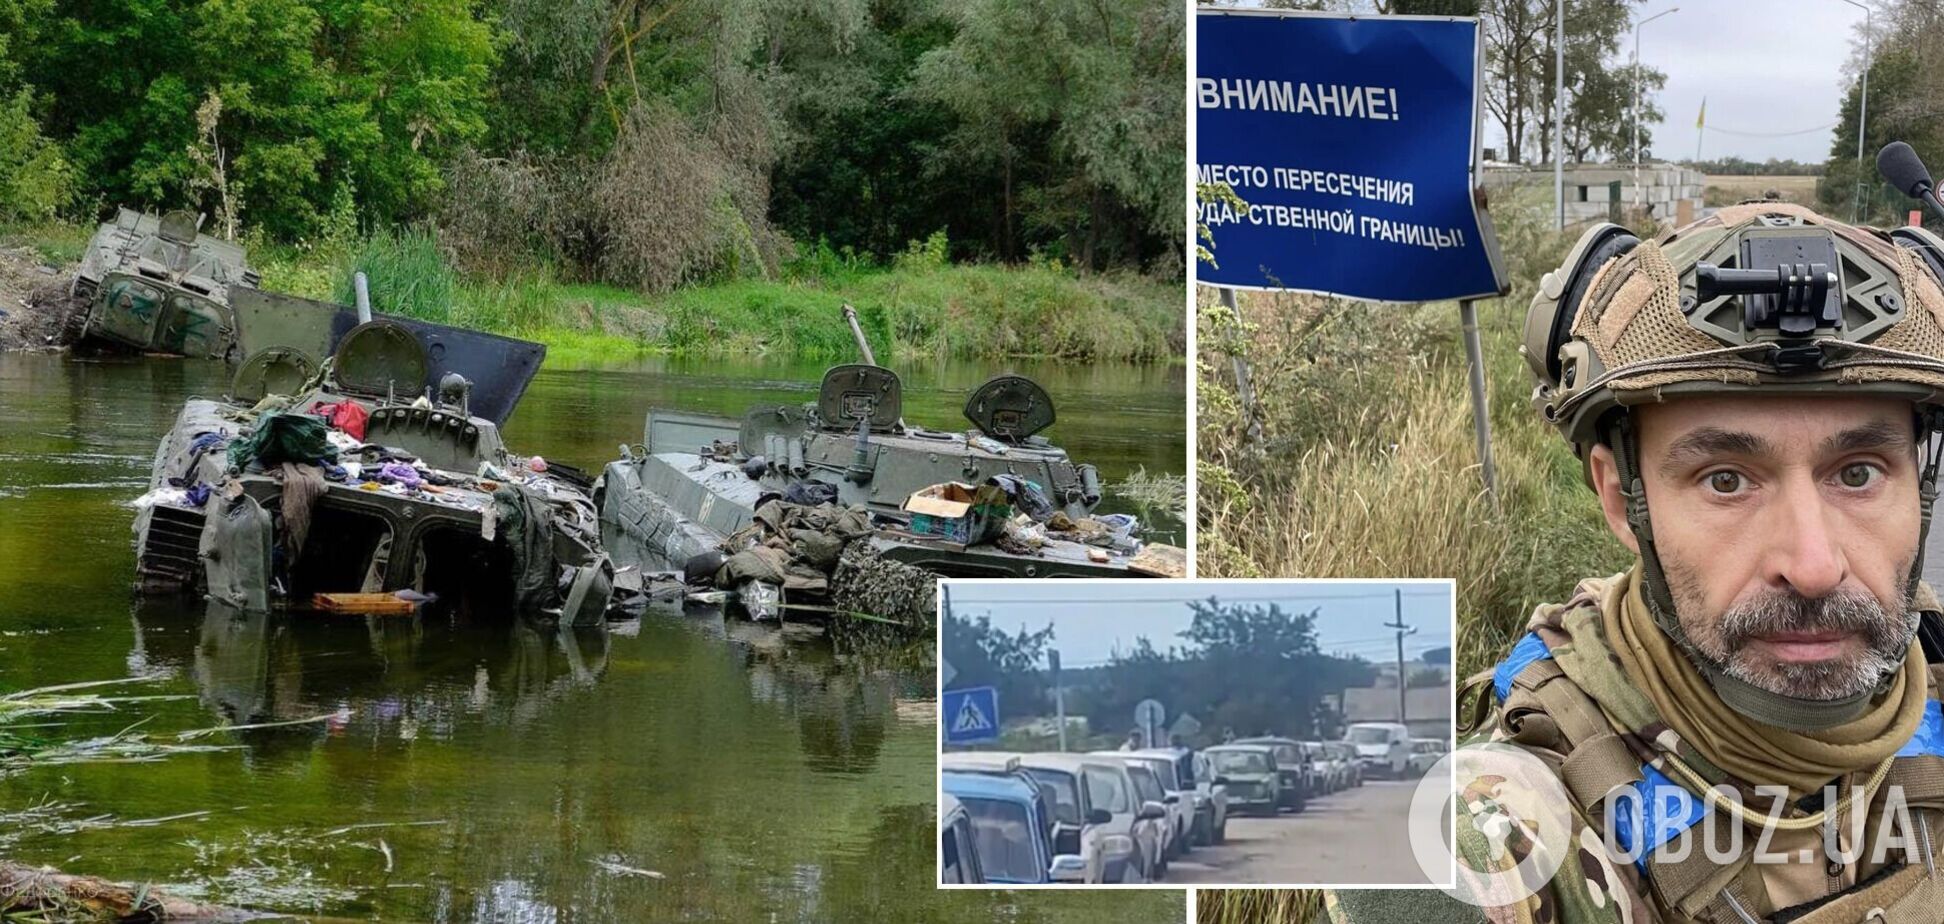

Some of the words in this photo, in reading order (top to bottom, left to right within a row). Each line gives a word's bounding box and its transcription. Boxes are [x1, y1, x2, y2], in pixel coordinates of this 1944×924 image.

[1197, 78, 1399, 121] ВНИМАНИЕ!
[1197, 164, 1269, 188] МЕСТО
[1273, 167, 1414, 206] ПЕРЕСЕЧЕНИЯ
[1360, 216, 1466, 250] ГРАНИЦЫ!
